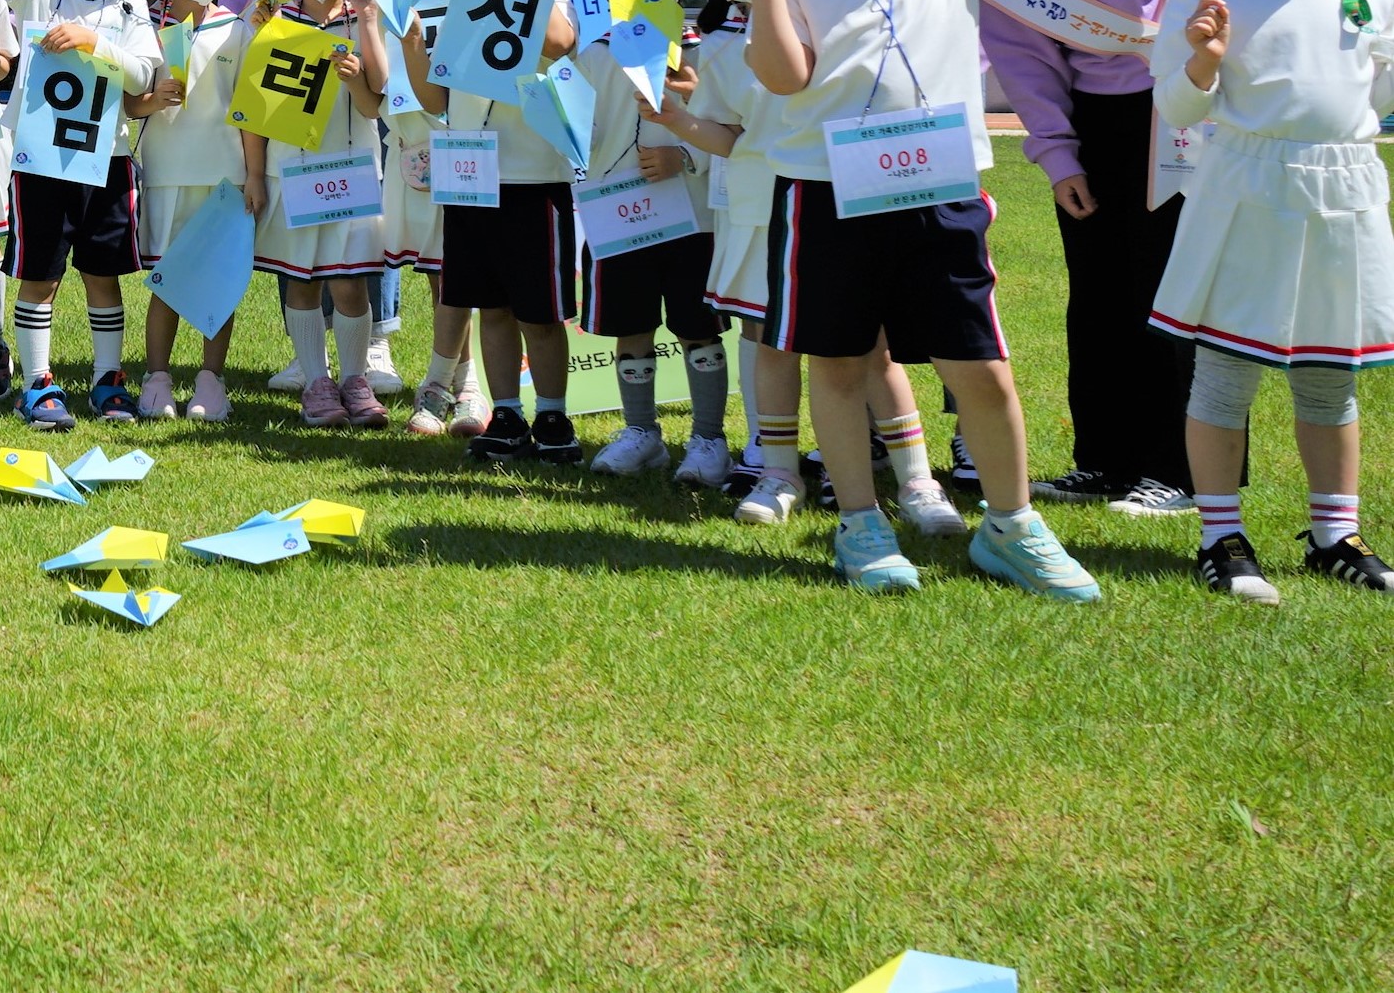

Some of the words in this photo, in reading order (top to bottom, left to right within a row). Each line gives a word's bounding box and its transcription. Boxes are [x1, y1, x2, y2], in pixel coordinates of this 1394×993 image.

[261, 47, 327, 114] 려
[43, 71, 110, 154] 임
[454, 160, 476, 174] 022
[879, 147, 927, 170] 008
[314, 179, 348, 195] 003
[618, 197, 651, 218] 067
